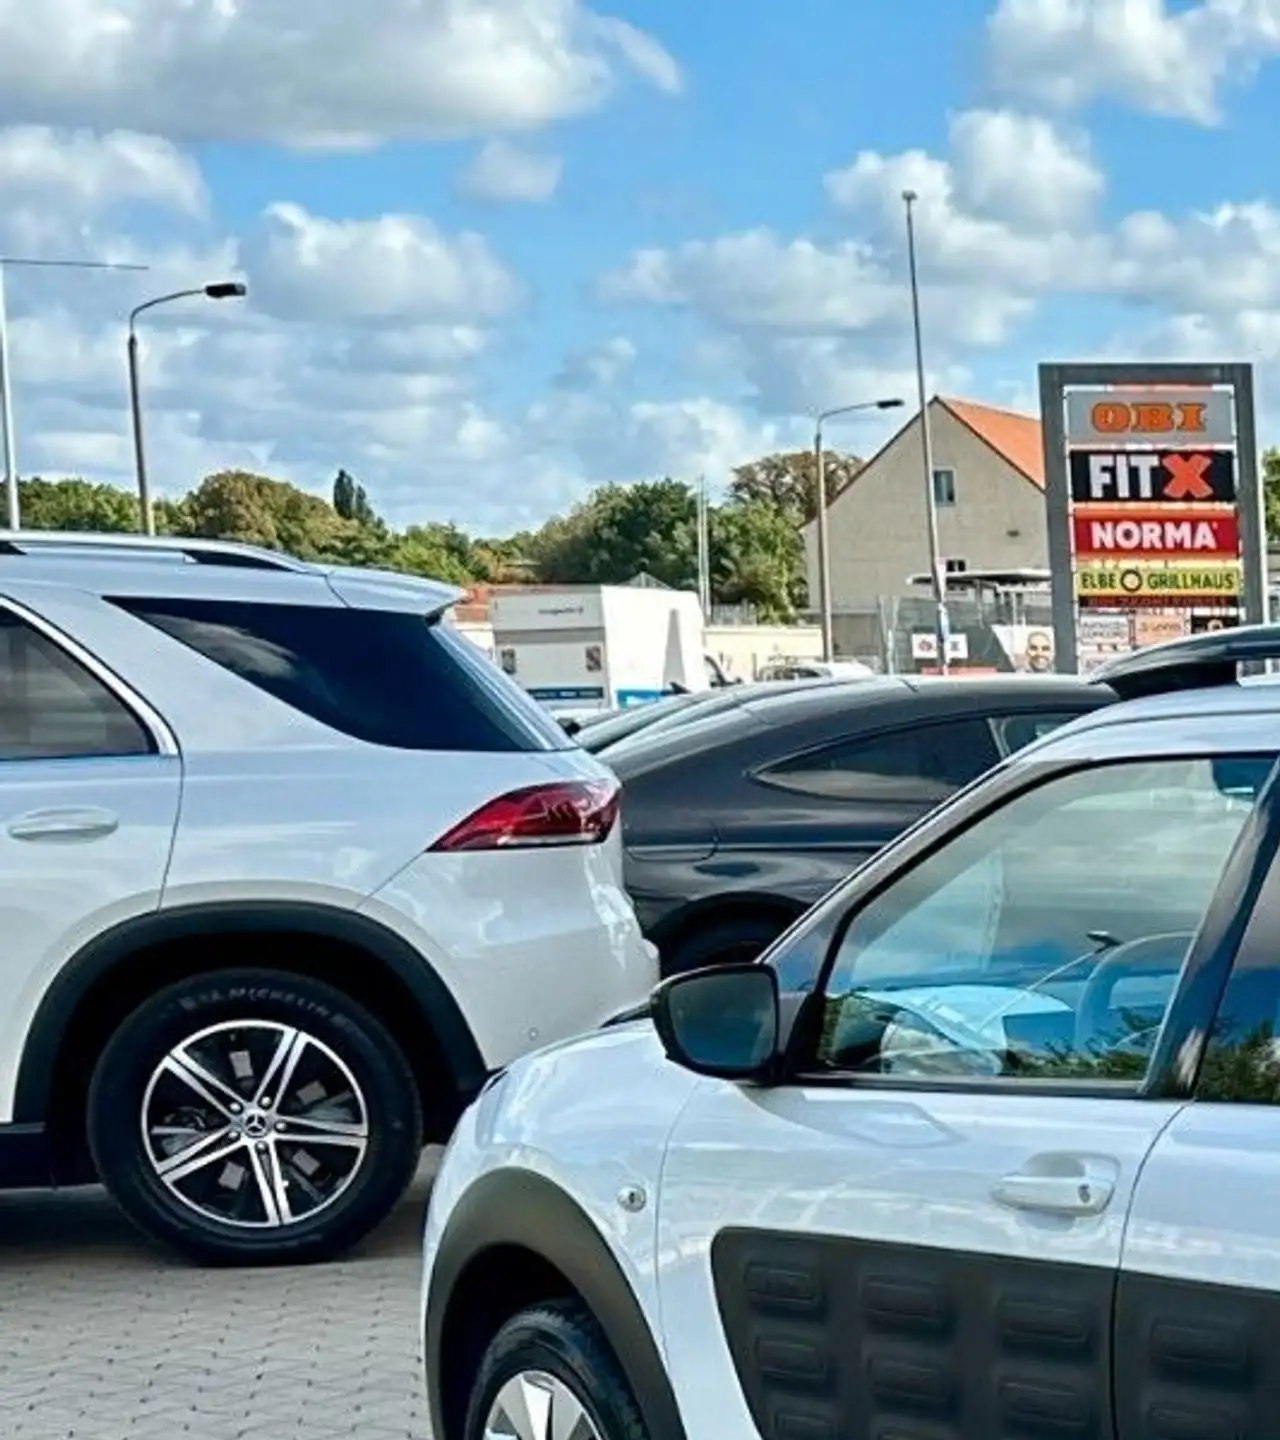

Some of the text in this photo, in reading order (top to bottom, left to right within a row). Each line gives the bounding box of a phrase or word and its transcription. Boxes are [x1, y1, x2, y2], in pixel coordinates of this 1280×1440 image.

[1090, 402, 1207, 433] OBI
[1091, 521, 1217, 549] NORMA
[1082, 571, 1235, 590] ELBE GRILLHAUS
